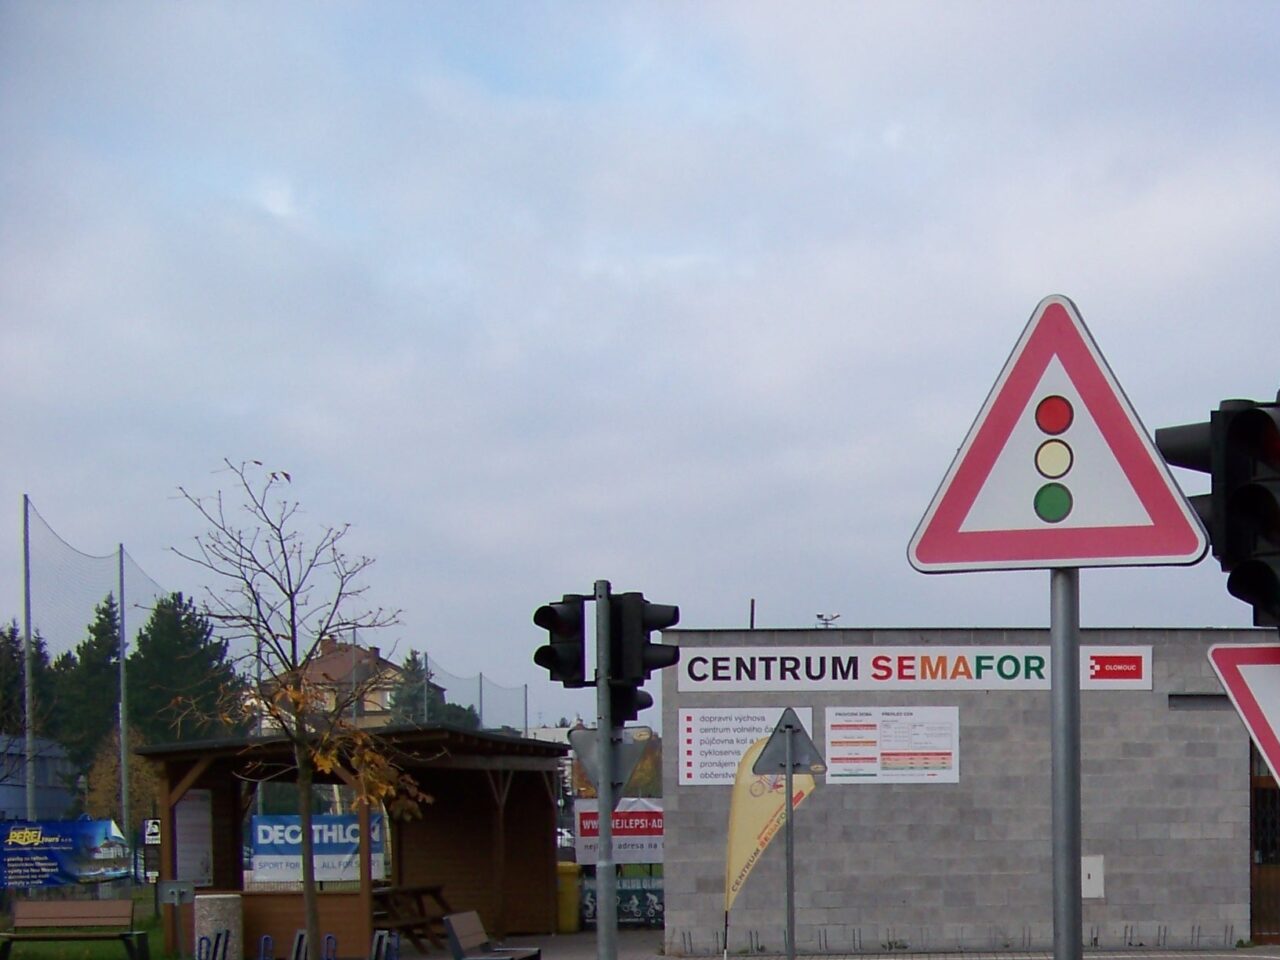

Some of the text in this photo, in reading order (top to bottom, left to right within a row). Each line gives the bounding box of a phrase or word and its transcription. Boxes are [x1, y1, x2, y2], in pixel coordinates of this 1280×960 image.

[687, 654, 1046, 682] CENTRUM SEMAFOR
[699, 714, 766, 723] dopravní výchova
[699, 726, 731, 734] centrum
[733, 726, 762, 734] volného
[699, 737, 734, 747] půjčovna
[736, 737, 747, 745] kol
[699, 749, 741, 757] cykloservis
[699, 760, 736, 769] pronájem
[699, 771, 737, 779] občerstve
[617, 842, 645, 850] adresa
[730, 846, 761, 893] CENTRUM
[759, 809, 789, 848] SEMAFO
[258, 861, 299, 870] SPORT FOR
[322, 861, 336, 869] ALL
